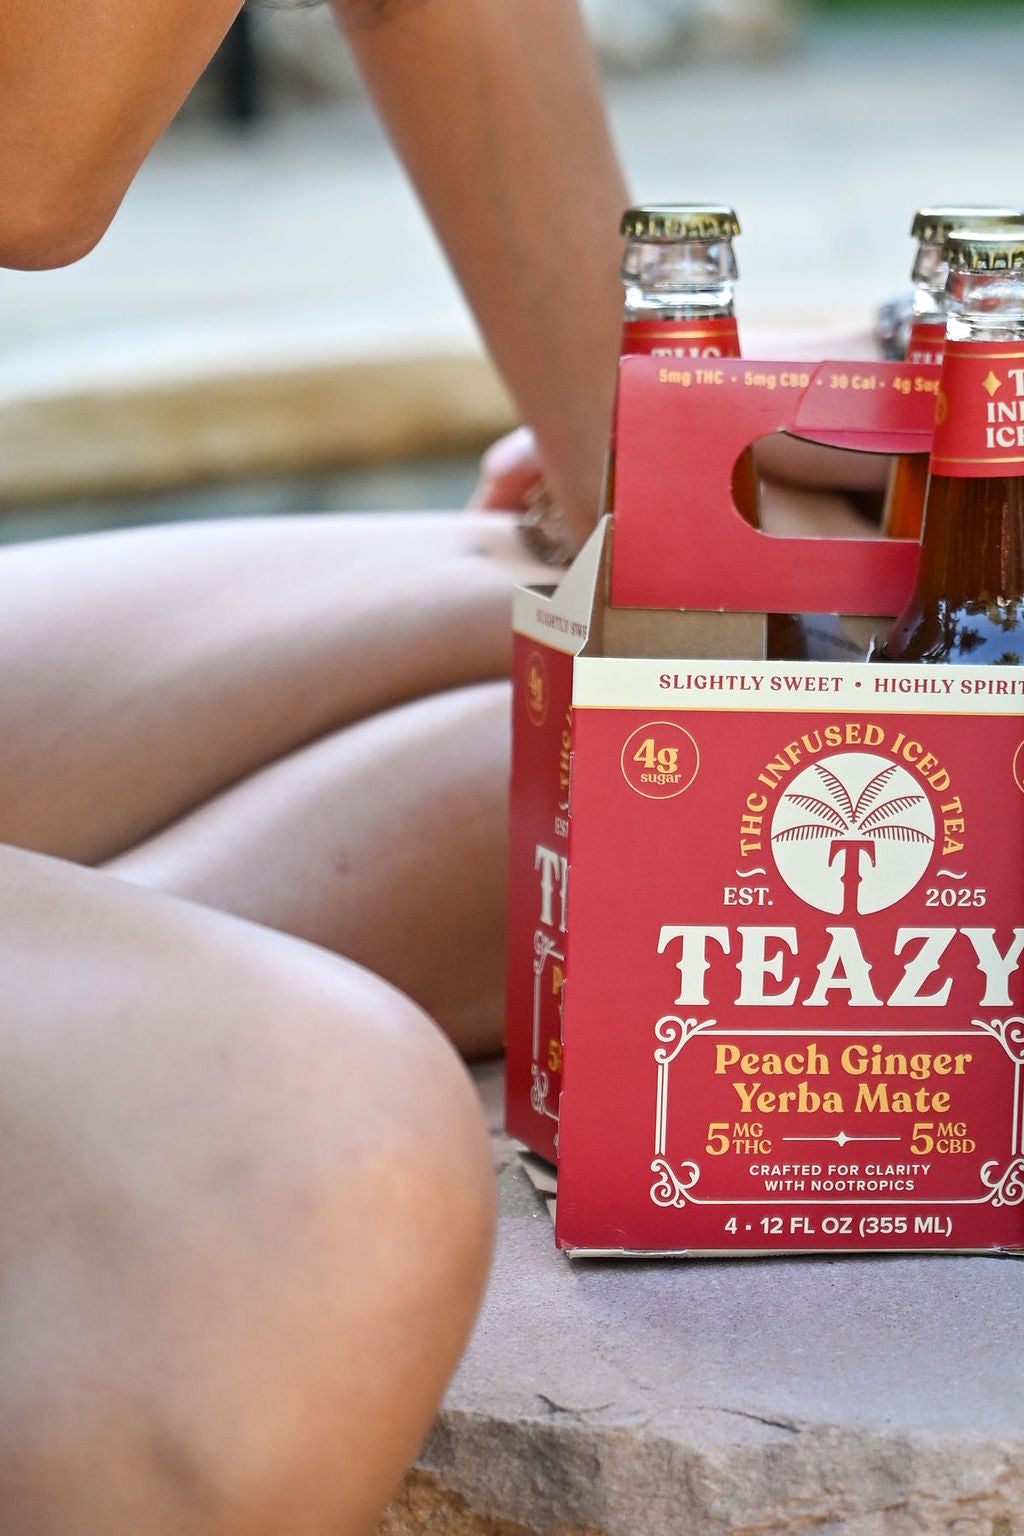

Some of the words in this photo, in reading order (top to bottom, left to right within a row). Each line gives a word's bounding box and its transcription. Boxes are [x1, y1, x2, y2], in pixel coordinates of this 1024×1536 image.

[659, 368, 691, 386] 5mg
[696, 369, 723, 384] THC
[744, 374, 776, 390] 5mg
[852, 376, 876, 390] Cal
[659, 674, 764, 692] SLIGHTLY
[770, 676, 843, 693] SWEET
[874, 677, 955, 695] HIGHLY
[633, 738, 679, 774] 4g
[640, 771, 682, 787] sugar
[740, 791, 768, 856] THC
[757, 723, 885, 790] INFUSED
[890, 733, 950, 791] ICED
[940, 796, 965, 855] TEA
[723, 887, 773, 906] EST.
[925, 888, 987, 907] 2025
[714, 1043, 829, 1075] Peach
[840, 1044, 972, 1081] Ginger
[733, 1082, 843, 1114] Yerba
[854, 1084, 951, 1114] Mate
[749, 1164, 823, 1176] CRAFTED
[827, 1164, 859, 1176] FOR
[864, 1164, 931, 1176] CLARITY
[764, 1179, 807, 1192] WITH
[810, 1179, 915, 1192] NOOTROPICS
[760, 1218, 783, 1234] 12
[790, 1218, 816, 1234] FL
[821, 1217, 853, 1234] OZ
[859, 1216, 908, 1237] (355
[914, 1216, 953, 1236] ML)
